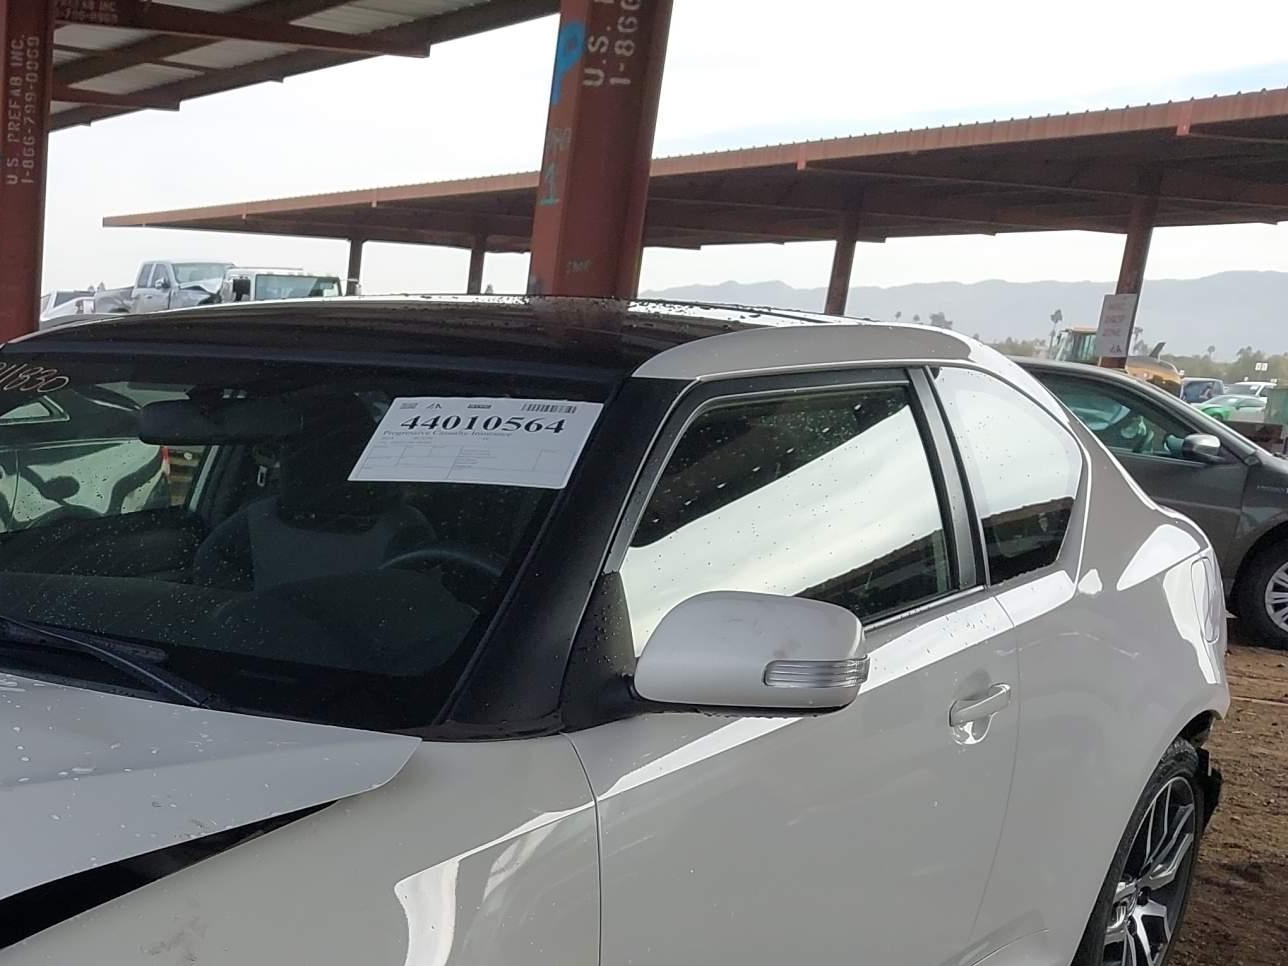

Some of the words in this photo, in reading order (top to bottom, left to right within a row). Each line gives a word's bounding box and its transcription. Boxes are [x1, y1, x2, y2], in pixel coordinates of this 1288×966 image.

[10, 34, 24, 67] INC.
[582, 26, 612, 87] U.S.
[8, 75, 23, 143] PREFAB
[21, 36, 40, 184] 1-866-799-0069
[400, 414, 566, 434] 44010564
